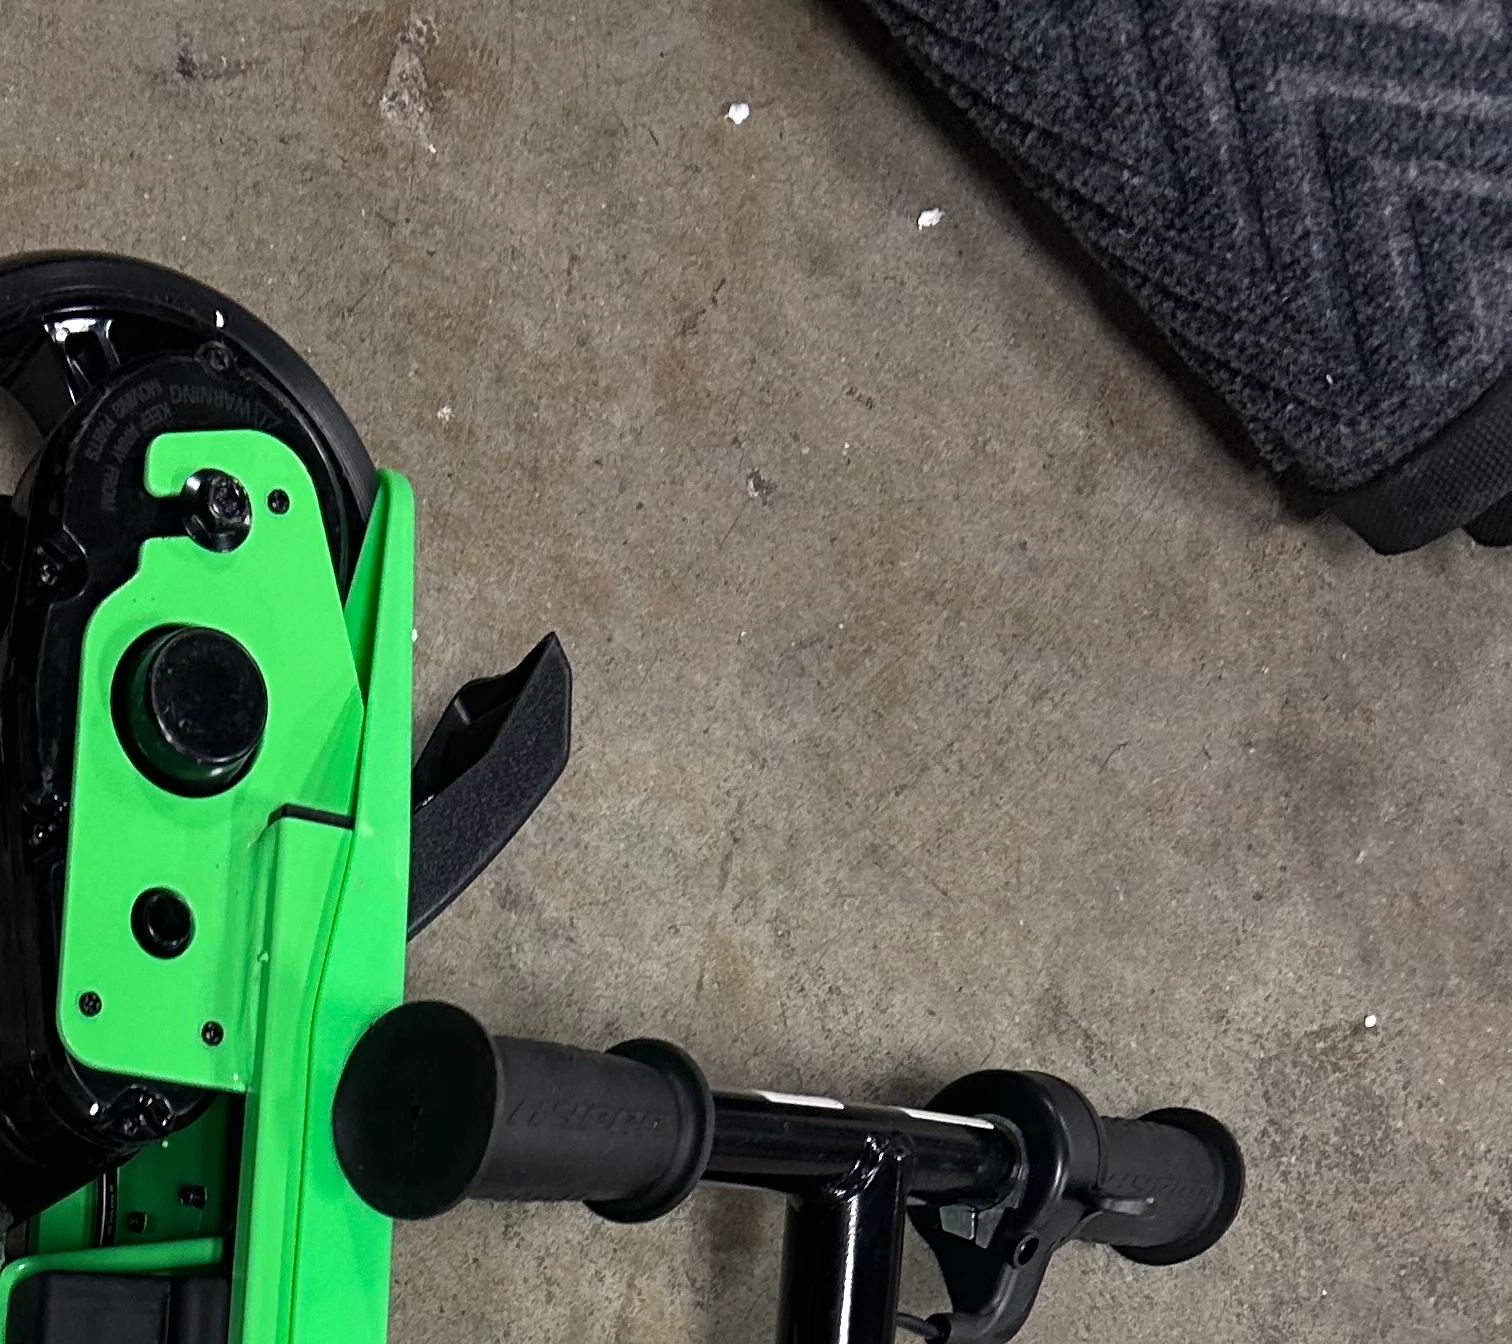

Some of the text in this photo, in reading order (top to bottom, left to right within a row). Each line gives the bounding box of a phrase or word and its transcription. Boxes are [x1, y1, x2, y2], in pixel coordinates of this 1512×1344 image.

[169, 384, 249, 414] WARNING
[84, 377, 161, 461] MOVING PARTS
[139, 401, 171, 429] KEEP
